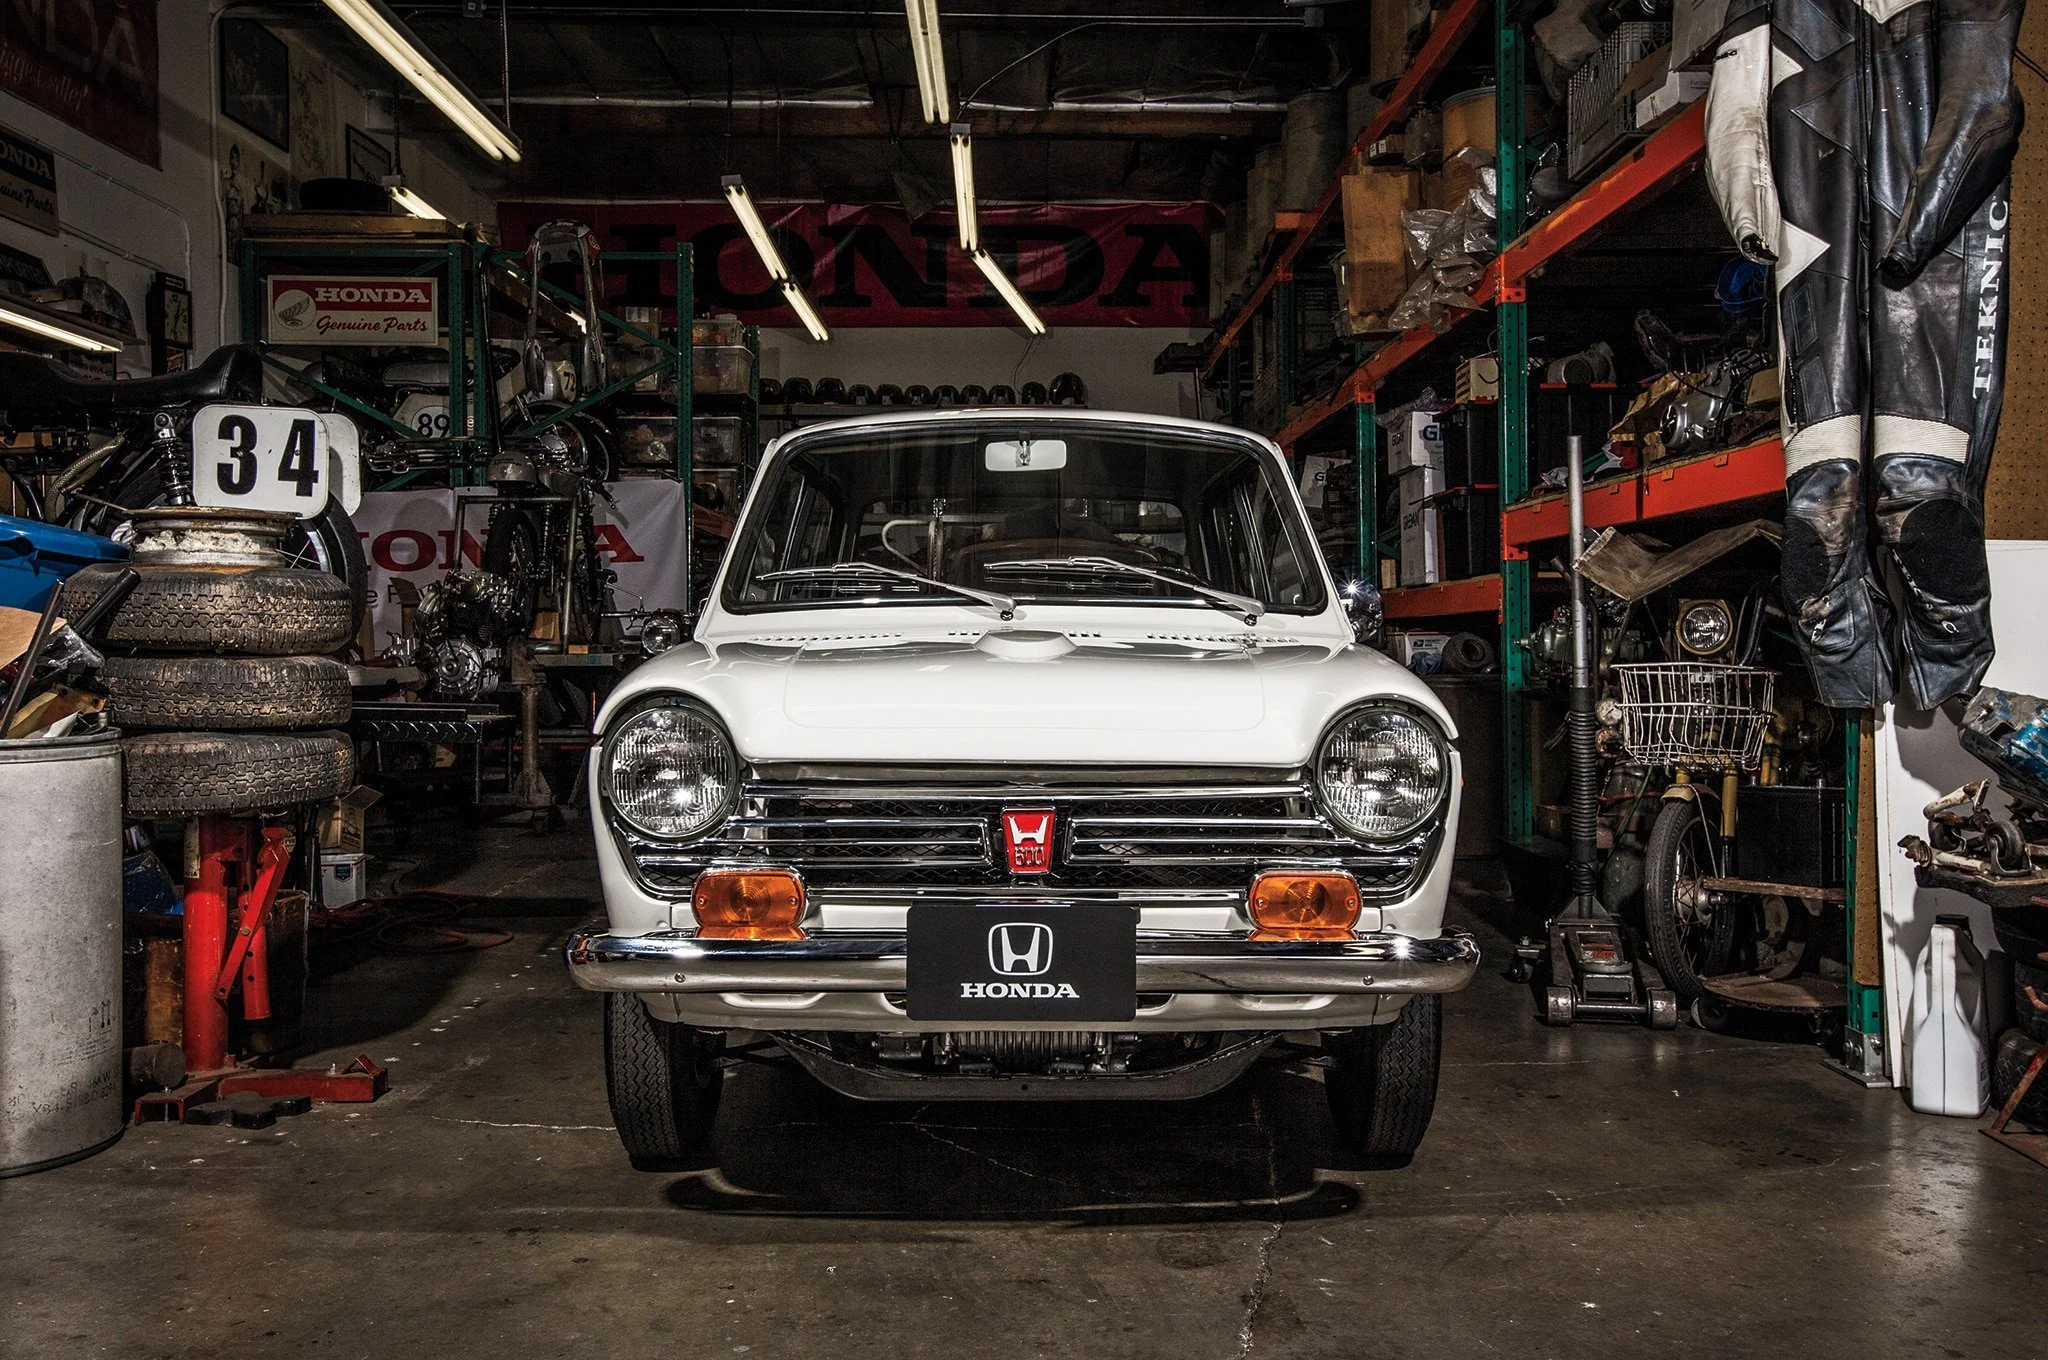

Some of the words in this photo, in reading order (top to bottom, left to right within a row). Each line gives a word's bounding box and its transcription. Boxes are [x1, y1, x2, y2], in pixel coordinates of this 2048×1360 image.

[24, 187, 55, 217] Parts
[315, 287, 430, 304] HONDA
[1972, 200, 2009, 400] TEKNIC
[316, 315, 381, 335] Genuine
[382, 316, 428, 334] Parts
[1014, 846, 1045, 866] 600
[960, 982, 1080, 999] HONDA
